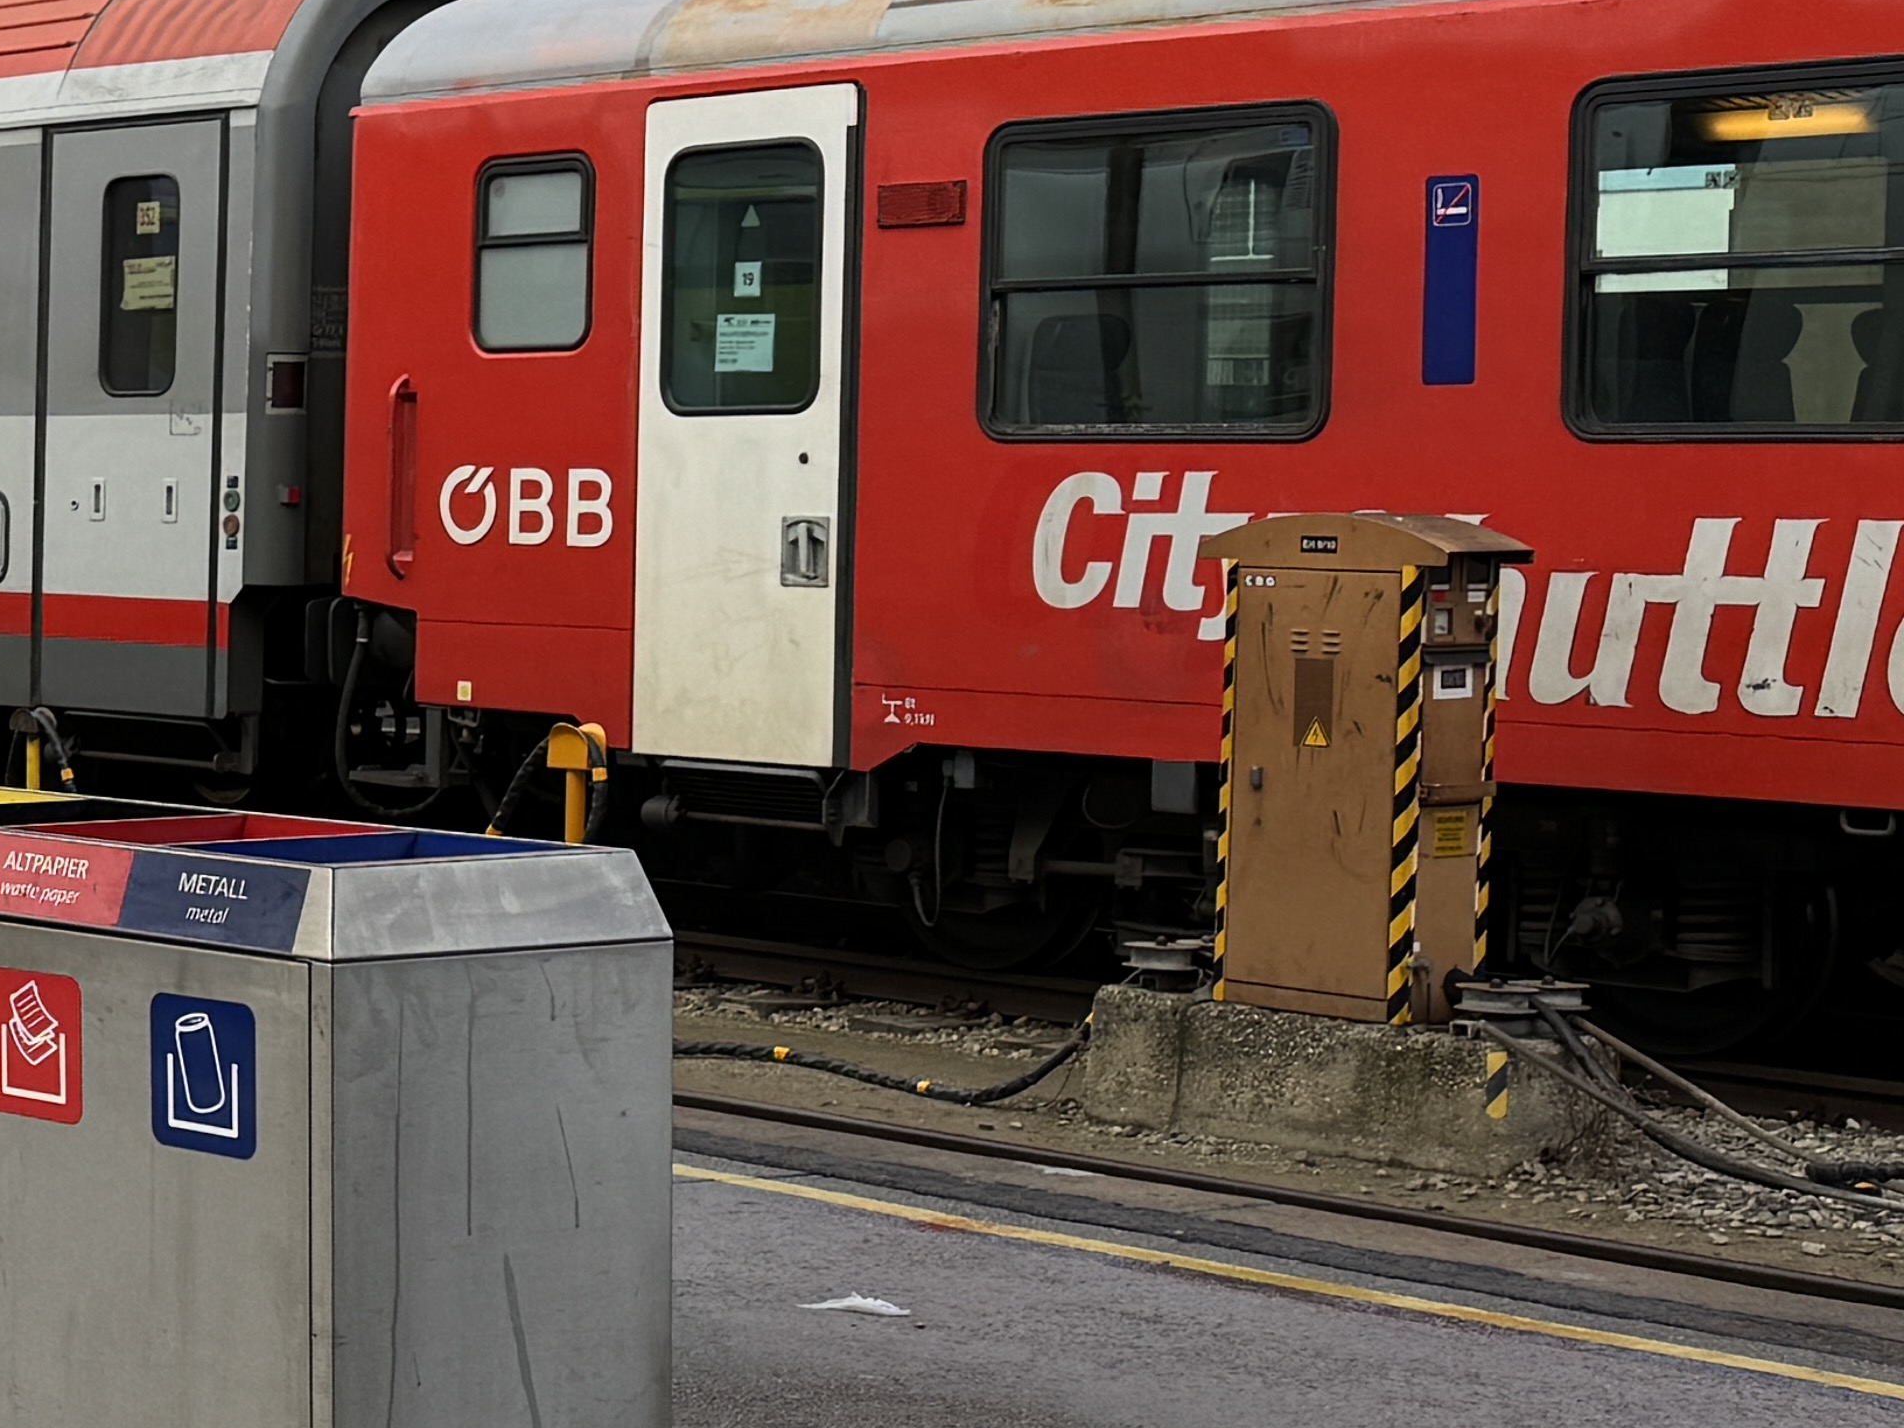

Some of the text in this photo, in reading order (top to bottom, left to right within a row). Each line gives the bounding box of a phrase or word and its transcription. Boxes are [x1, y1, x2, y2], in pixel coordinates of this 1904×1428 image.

[439, 464, 614, 548] ÖBB
[2, 850, 90, 880] ALTPAPIER
[0, 881, 81, 907] waste paper
[177, 871, 248, 900] METALL
[185, 906, 230, 924] metal
